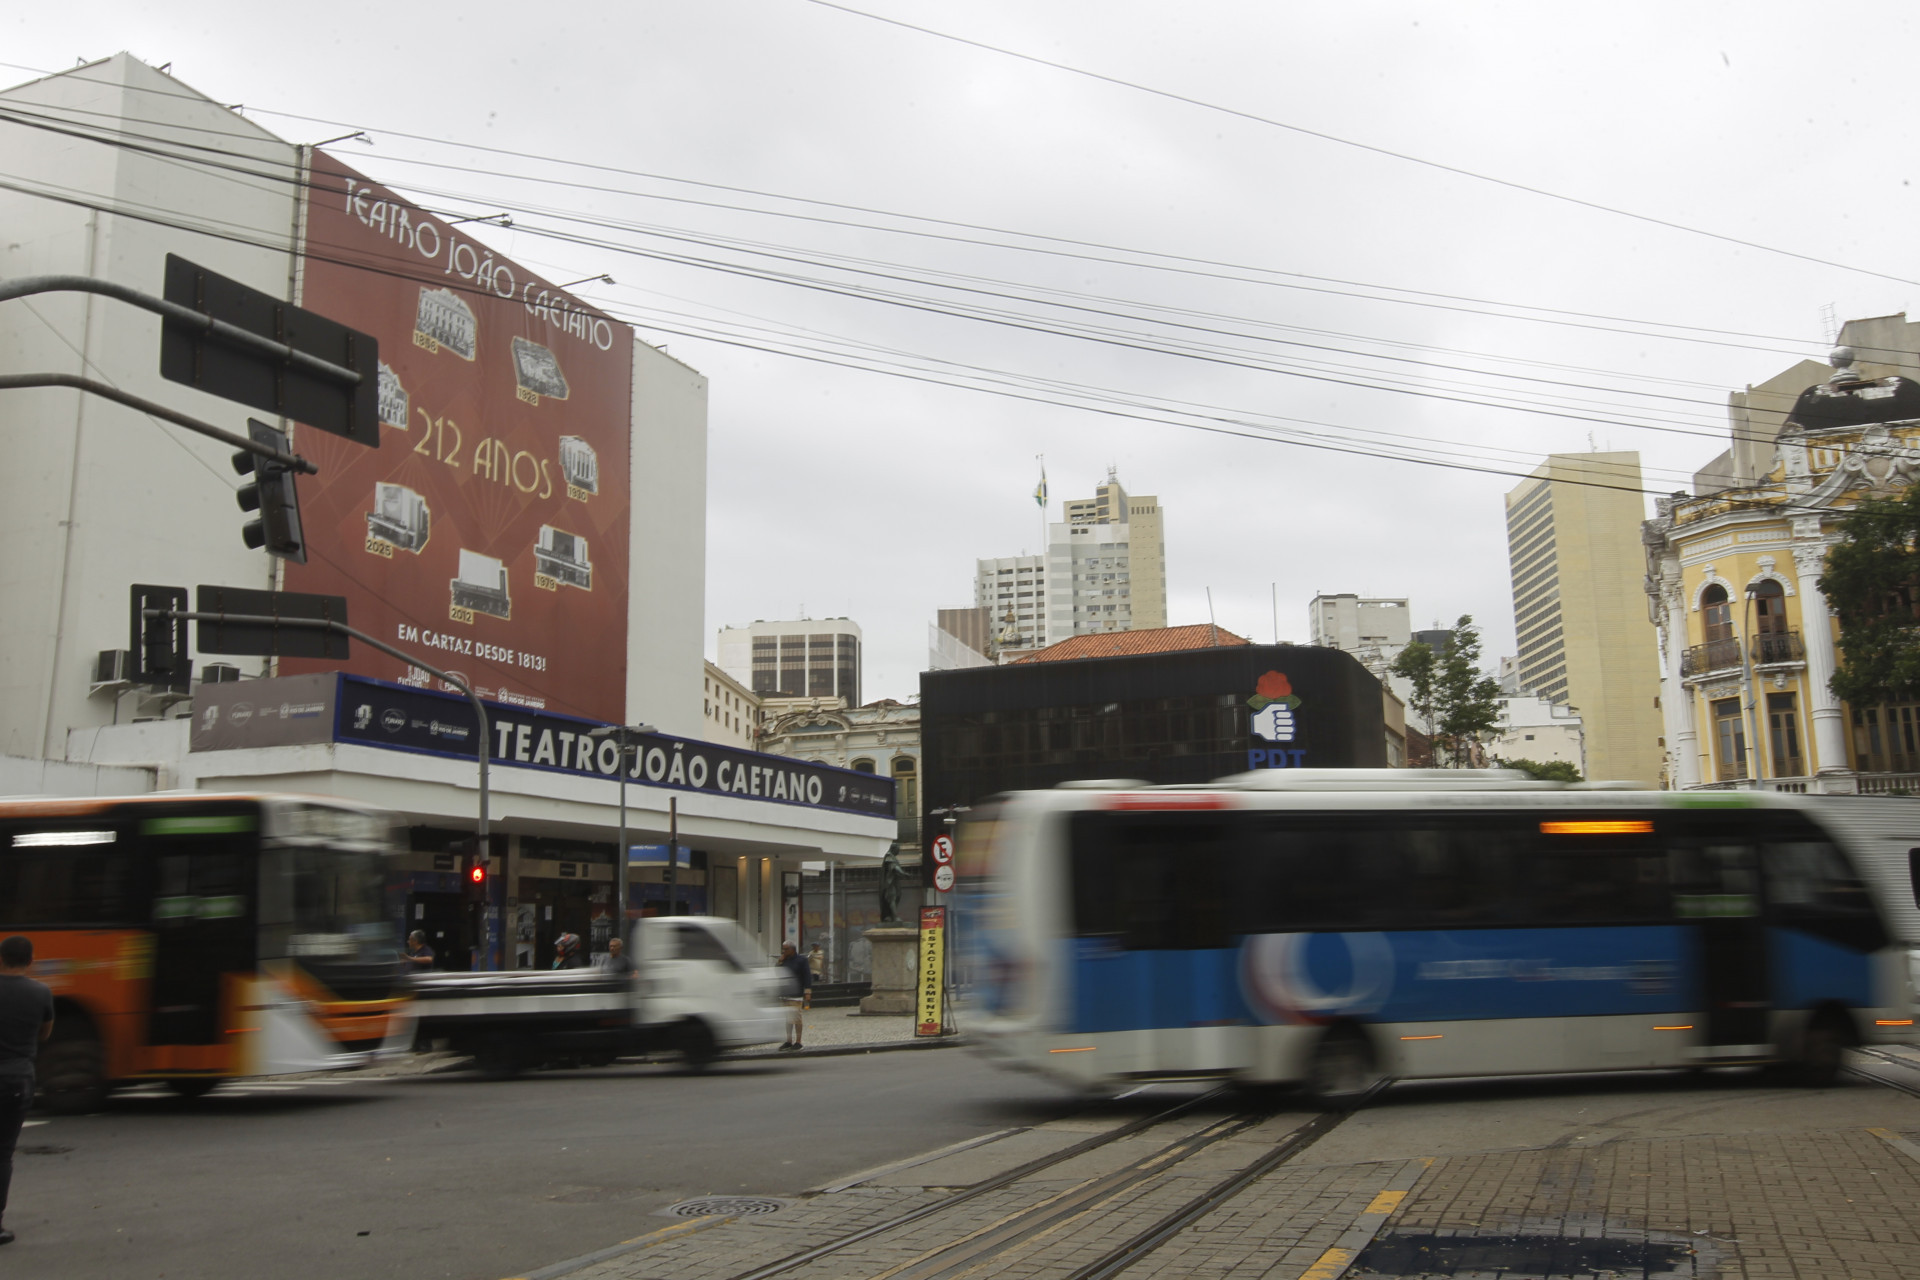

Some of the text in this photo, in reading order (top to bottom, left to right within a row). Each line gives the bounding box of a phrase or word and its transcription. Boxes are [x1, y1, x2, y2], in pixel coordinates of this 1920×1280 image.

[344, 178, 613, 351] TEATRO JOÃO CAETANO
[413, 406, 553, 500] 212 ANOS
[366, 539, 392, 557] 2025
[398, 624, 546, 672] EM CARTAZ DESDE 1813!
[451, 608, 472, 623] 2012
[495, 721, 823, 805] TEATRO JOÃO CAETANO
[1248, 748, 1306, 770] PDT
[925, 929, 936, 1024] ESTACIONAMENTO
